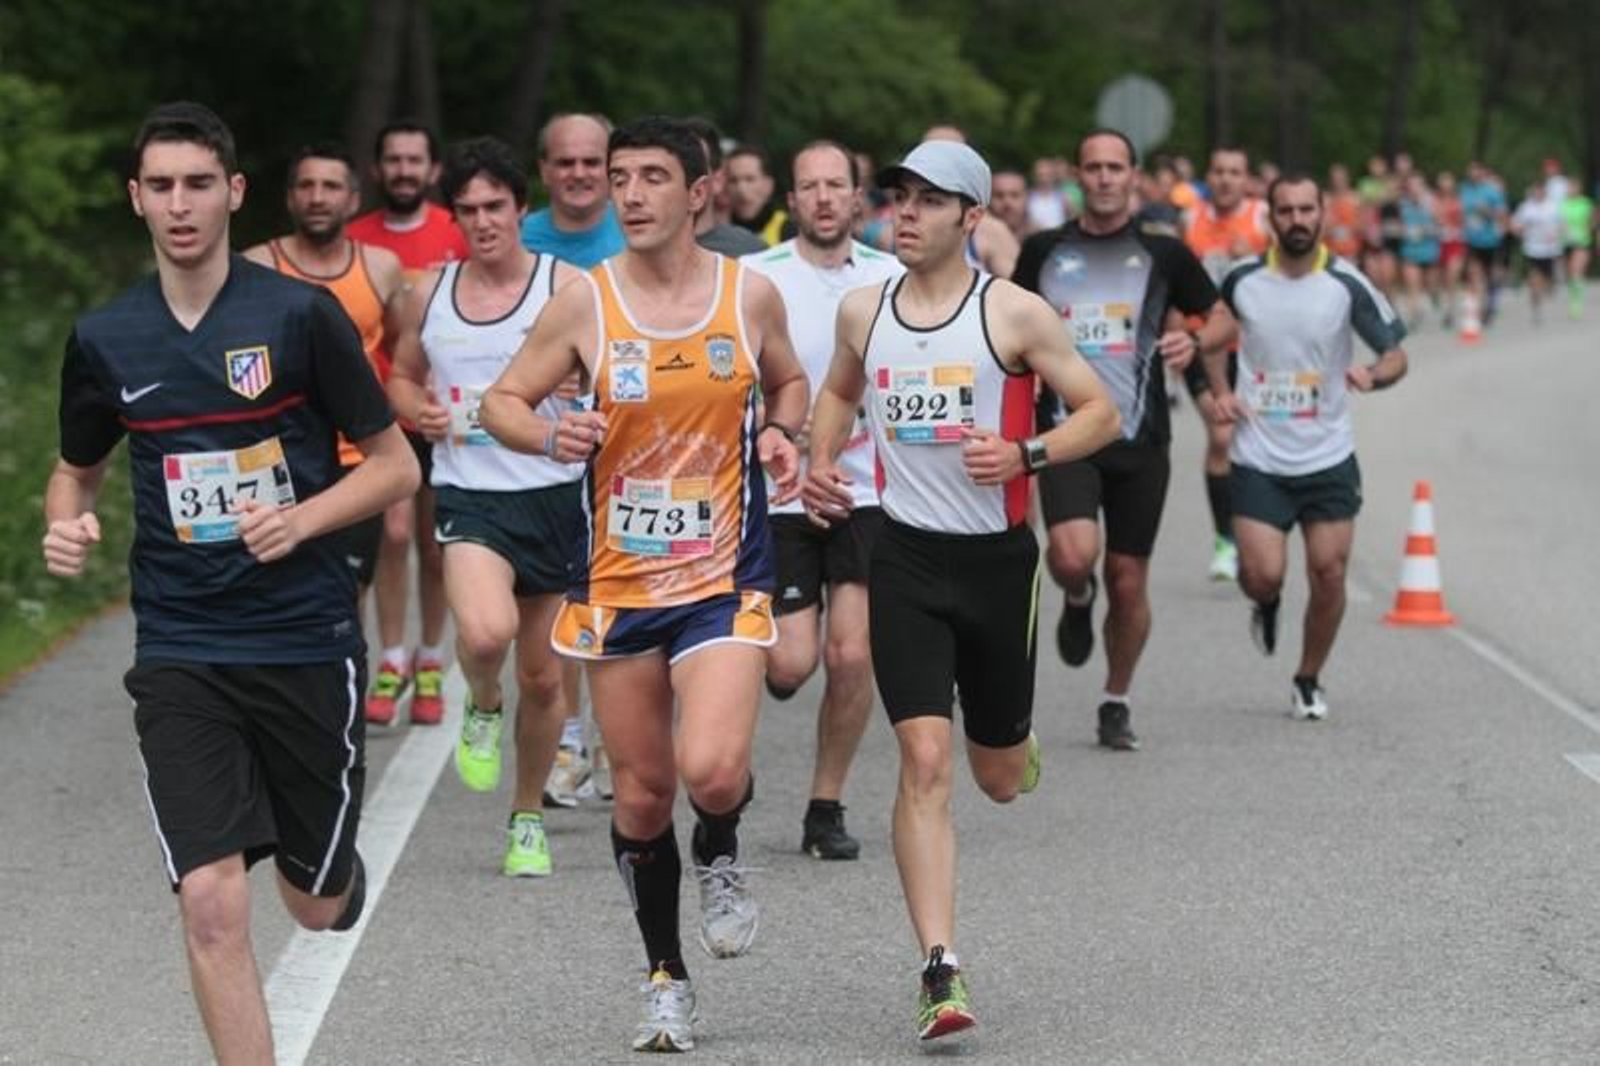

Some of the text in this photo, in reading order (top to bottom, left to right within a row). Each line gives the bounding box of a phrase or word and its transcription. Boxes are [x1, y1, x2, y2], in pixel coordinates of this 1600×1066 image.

[886, 393, 948, 421] 322
[180, 479, 258, 519] 347
[616, 503, 685, 536] 773
